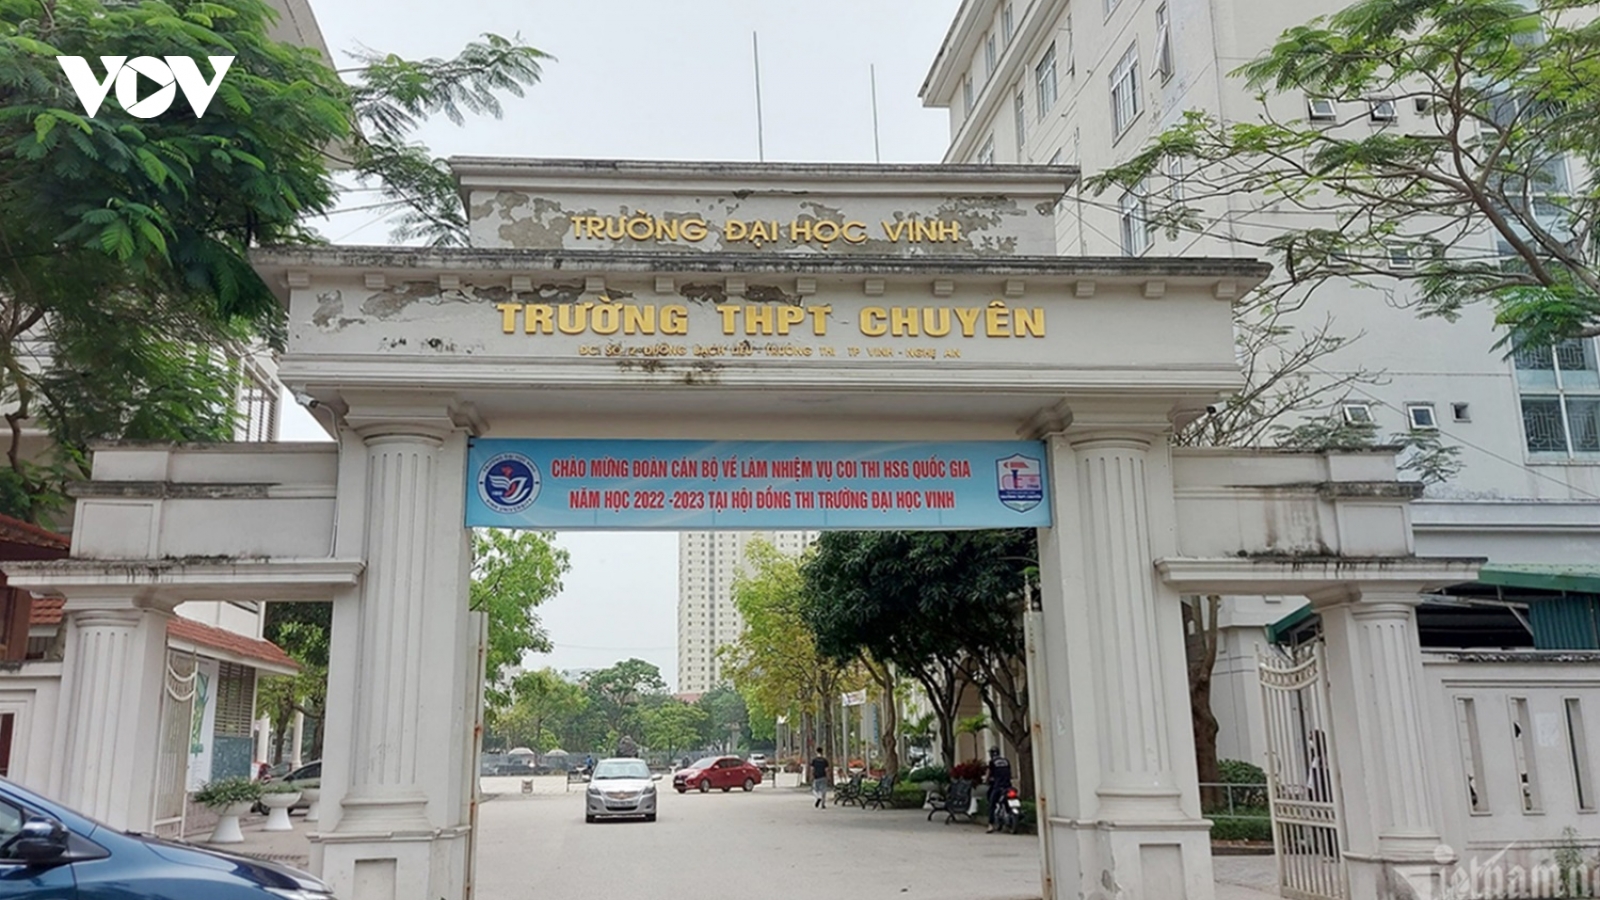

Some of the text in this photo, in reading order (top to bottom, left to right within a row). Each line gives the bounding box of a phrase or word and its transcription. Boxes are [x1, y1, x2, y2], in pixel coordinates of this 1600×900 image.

[571, 209, 960, 249] TRƯỜNG ĐẠI HỌC VINH
[497, 295, 1047, 337] TRƯỜNG THPT CHUYÊN
[943, 347, 961, 359] AN
[552, 455, 587, 478] CHÀO
[590, 455, 630, 478] MỪNG
[633, 455, 668, 478] ĐOÀN
[671, 455, 698, 478] CÁN
[702, 455, 719, 482] BỘ
[741, 455, 768, 478] LÀM
[772, 455, 813, 482] NHIỆM
[816, 460, 833, 482] VỤ
[836, 460, 857, 478] COI
[861, 460, 880, 478] THI
[884, 460, 910, 478] HSG
[912, 453, 946, 480] QUỐC
[950, 460, 971, 478] GIA
[569, 486, 600, 509] NĂM
[604, 490, 630, 513] HỌC
[633, 490, 665, 509] 2022
[708, 490, 728, 513] TẠI
[731, 486, 753, 513] HỘI
[794, 490, 815, 509] THI
[818, 486, 868, 509] TRƯỜNG
[871, 490, 893, 513] ĐẠI
[896, 490, 922, 513] HỌC
[924, 490, 955, 509] VINH
